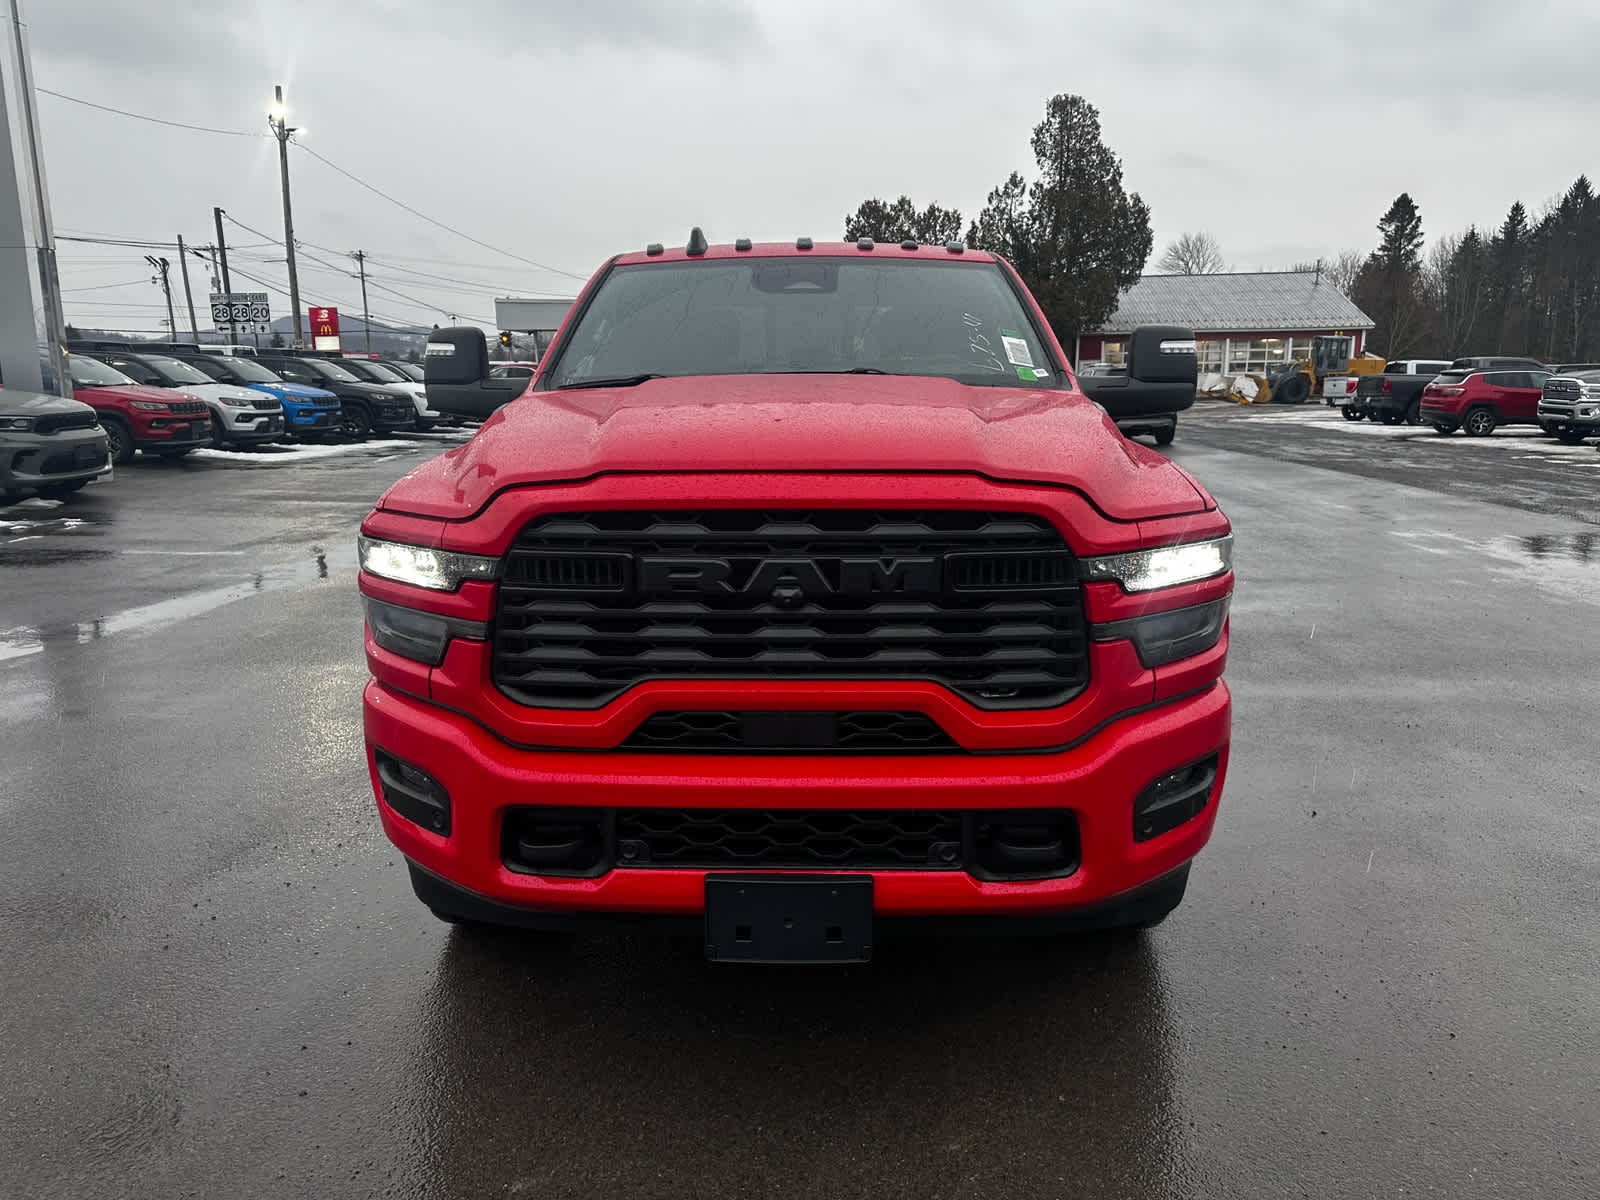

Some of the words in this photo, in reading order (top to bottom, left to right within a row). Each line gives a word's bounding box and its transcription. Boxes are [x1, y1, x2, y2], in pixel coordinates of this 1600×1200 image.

[214, 307, 228, 318] 28
[233, 307, 249, 318] 28
[252, 307, 268, 318] 20
[641, 557, 937, 593] RAM
